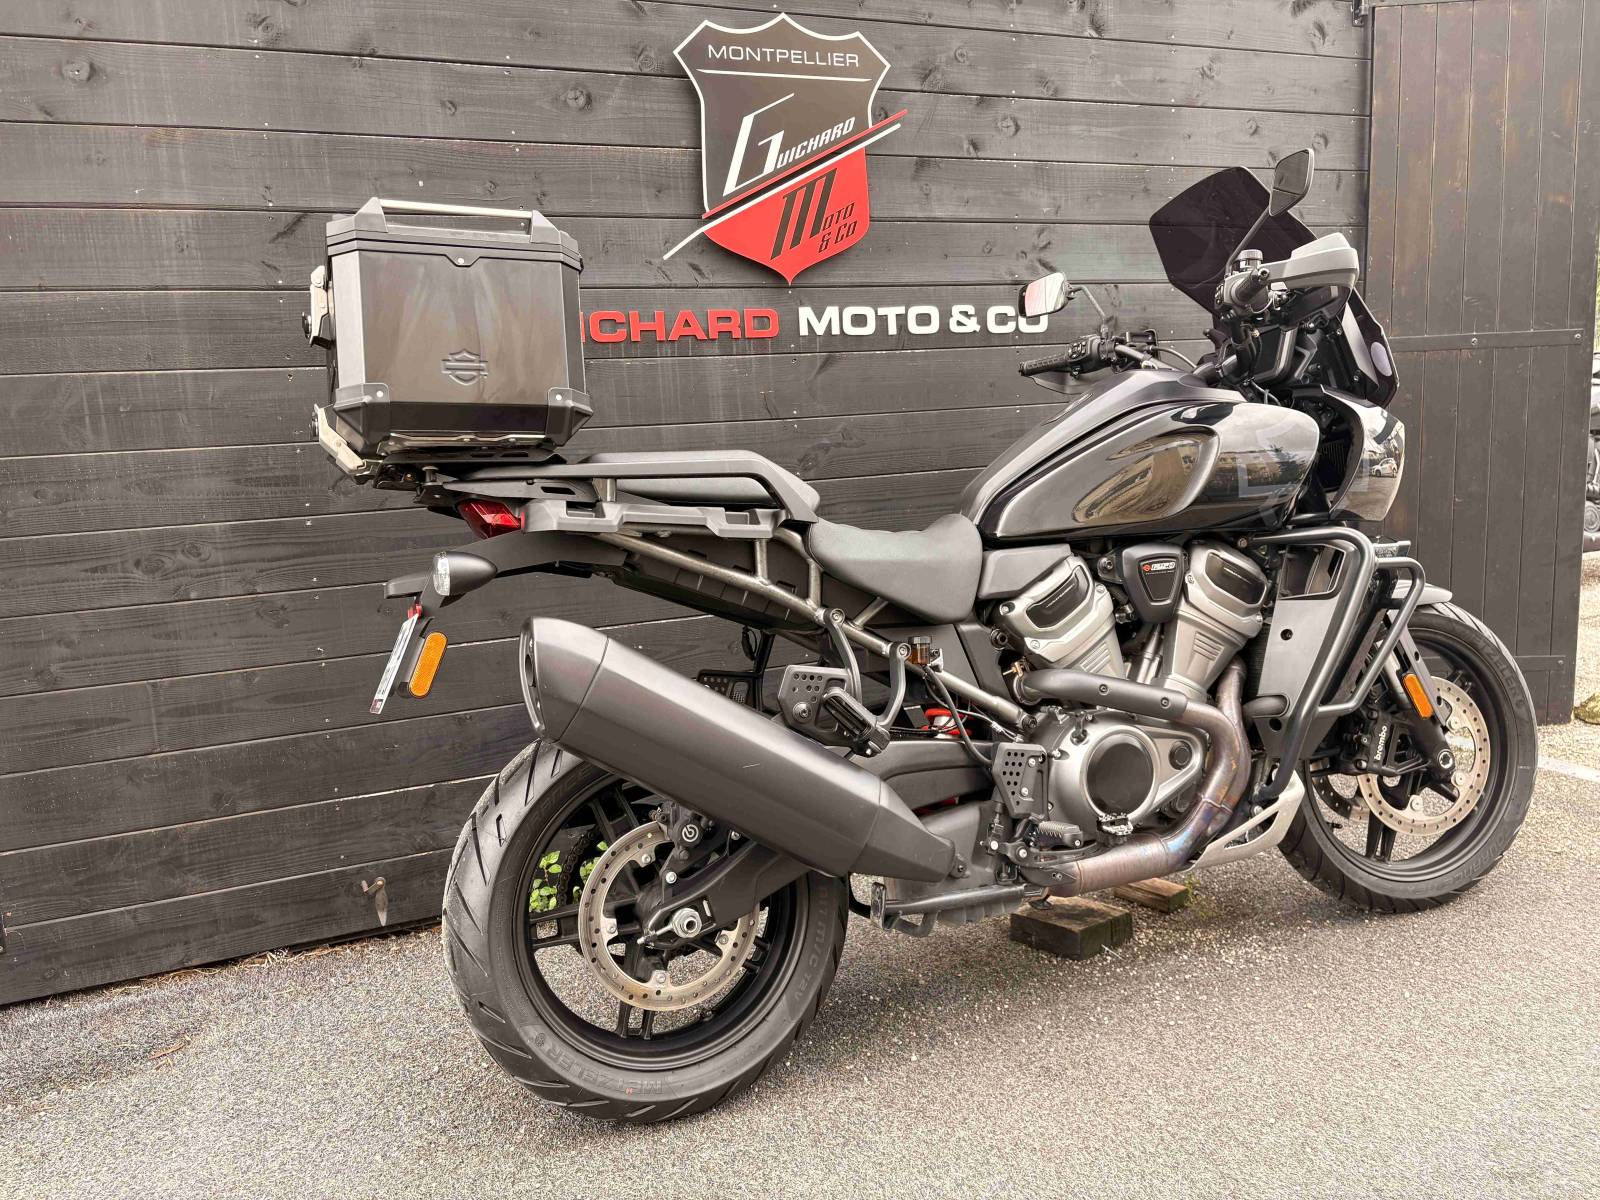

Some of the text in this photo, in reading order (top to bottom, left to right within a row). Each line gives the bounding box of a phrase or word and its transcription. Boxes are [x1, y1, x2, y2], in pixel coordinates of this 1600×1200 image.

[707, 44, 859, 67] MONTPELLIER
[834, 220, 858, 244] CO
[798, 305, 940, 336] MOTO
[949, 304, 981, 333] &
[986, 305, 1049, 334] CO
[1373, 725, 1388, 761] brembo
[546, 1042, 664, 1096] METZELER
